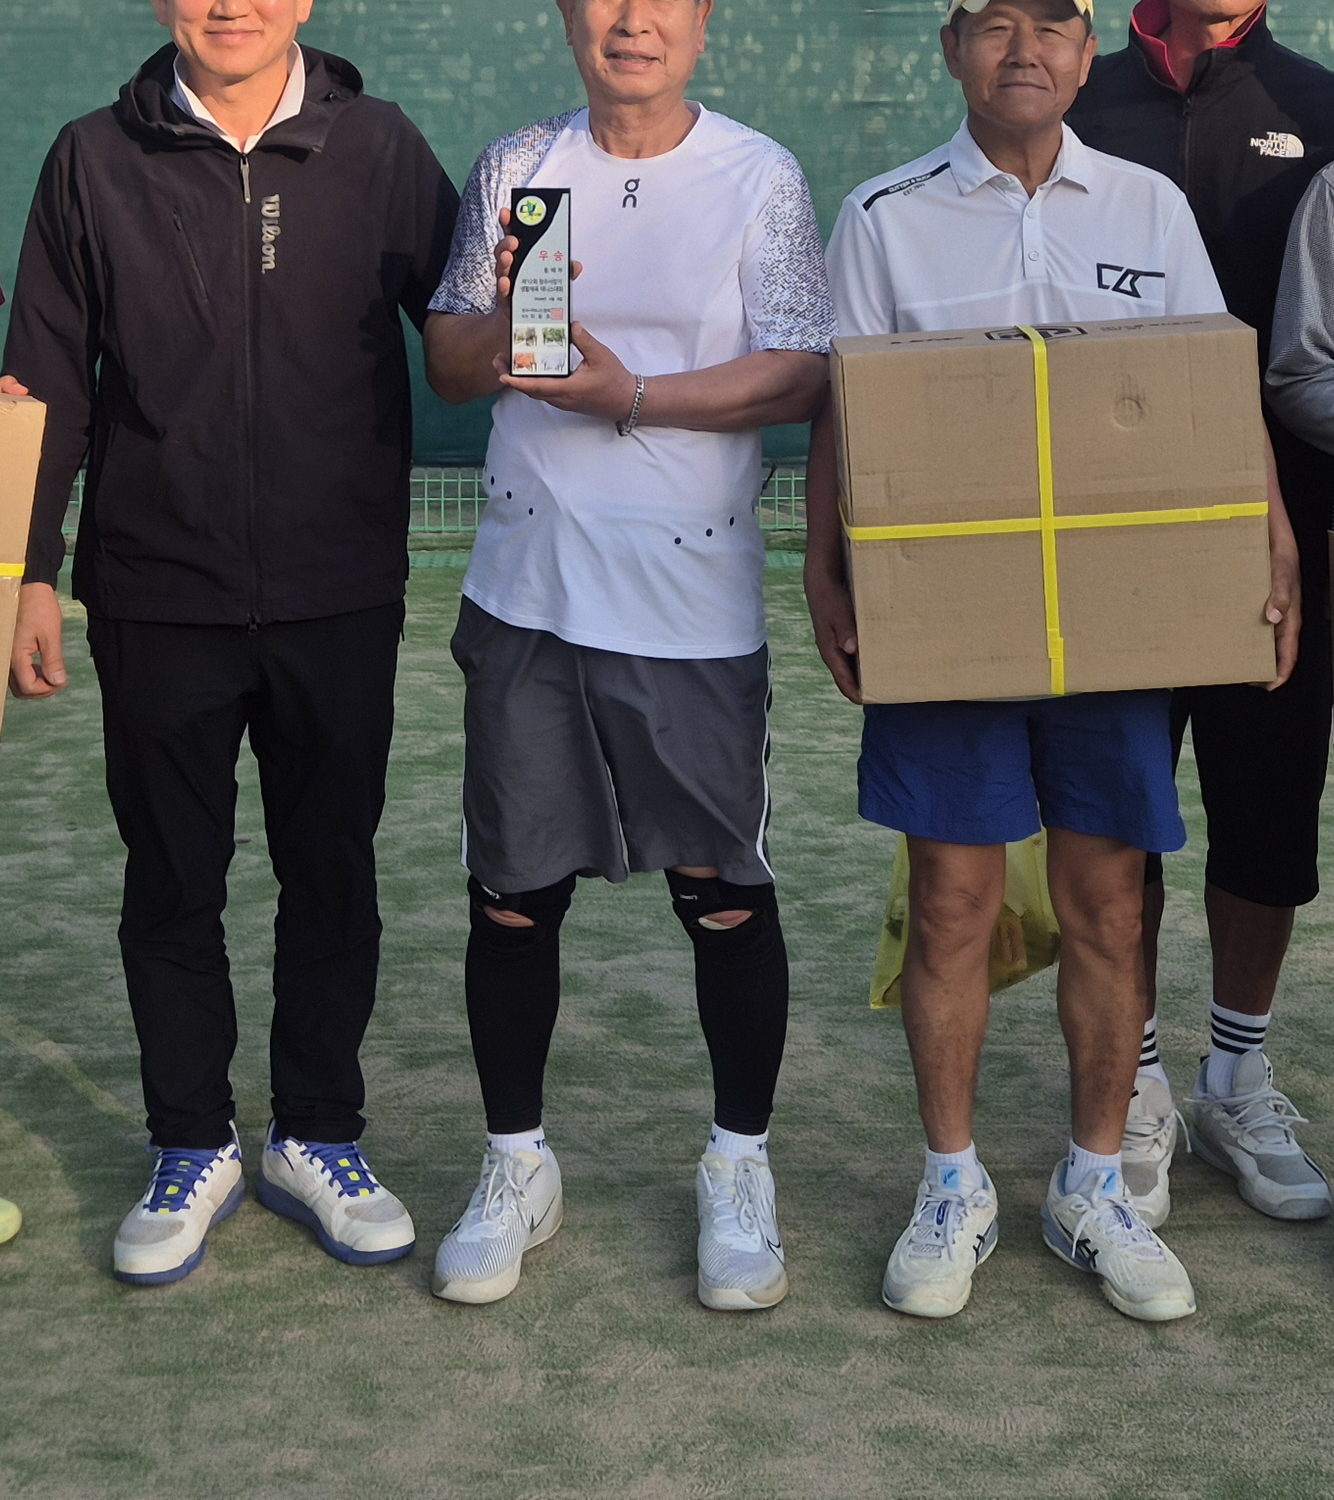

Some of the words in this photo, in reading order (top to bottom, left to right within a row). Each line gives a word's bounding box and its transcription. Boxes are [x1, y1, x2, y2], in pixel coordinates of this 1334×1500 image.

[1266, 131, 1288, 141] THE
[1250, 137, 1287, 149] NORTH
[1260, 147, 1286, 157] FACE
[261, 193, 281, 274] Wilson
